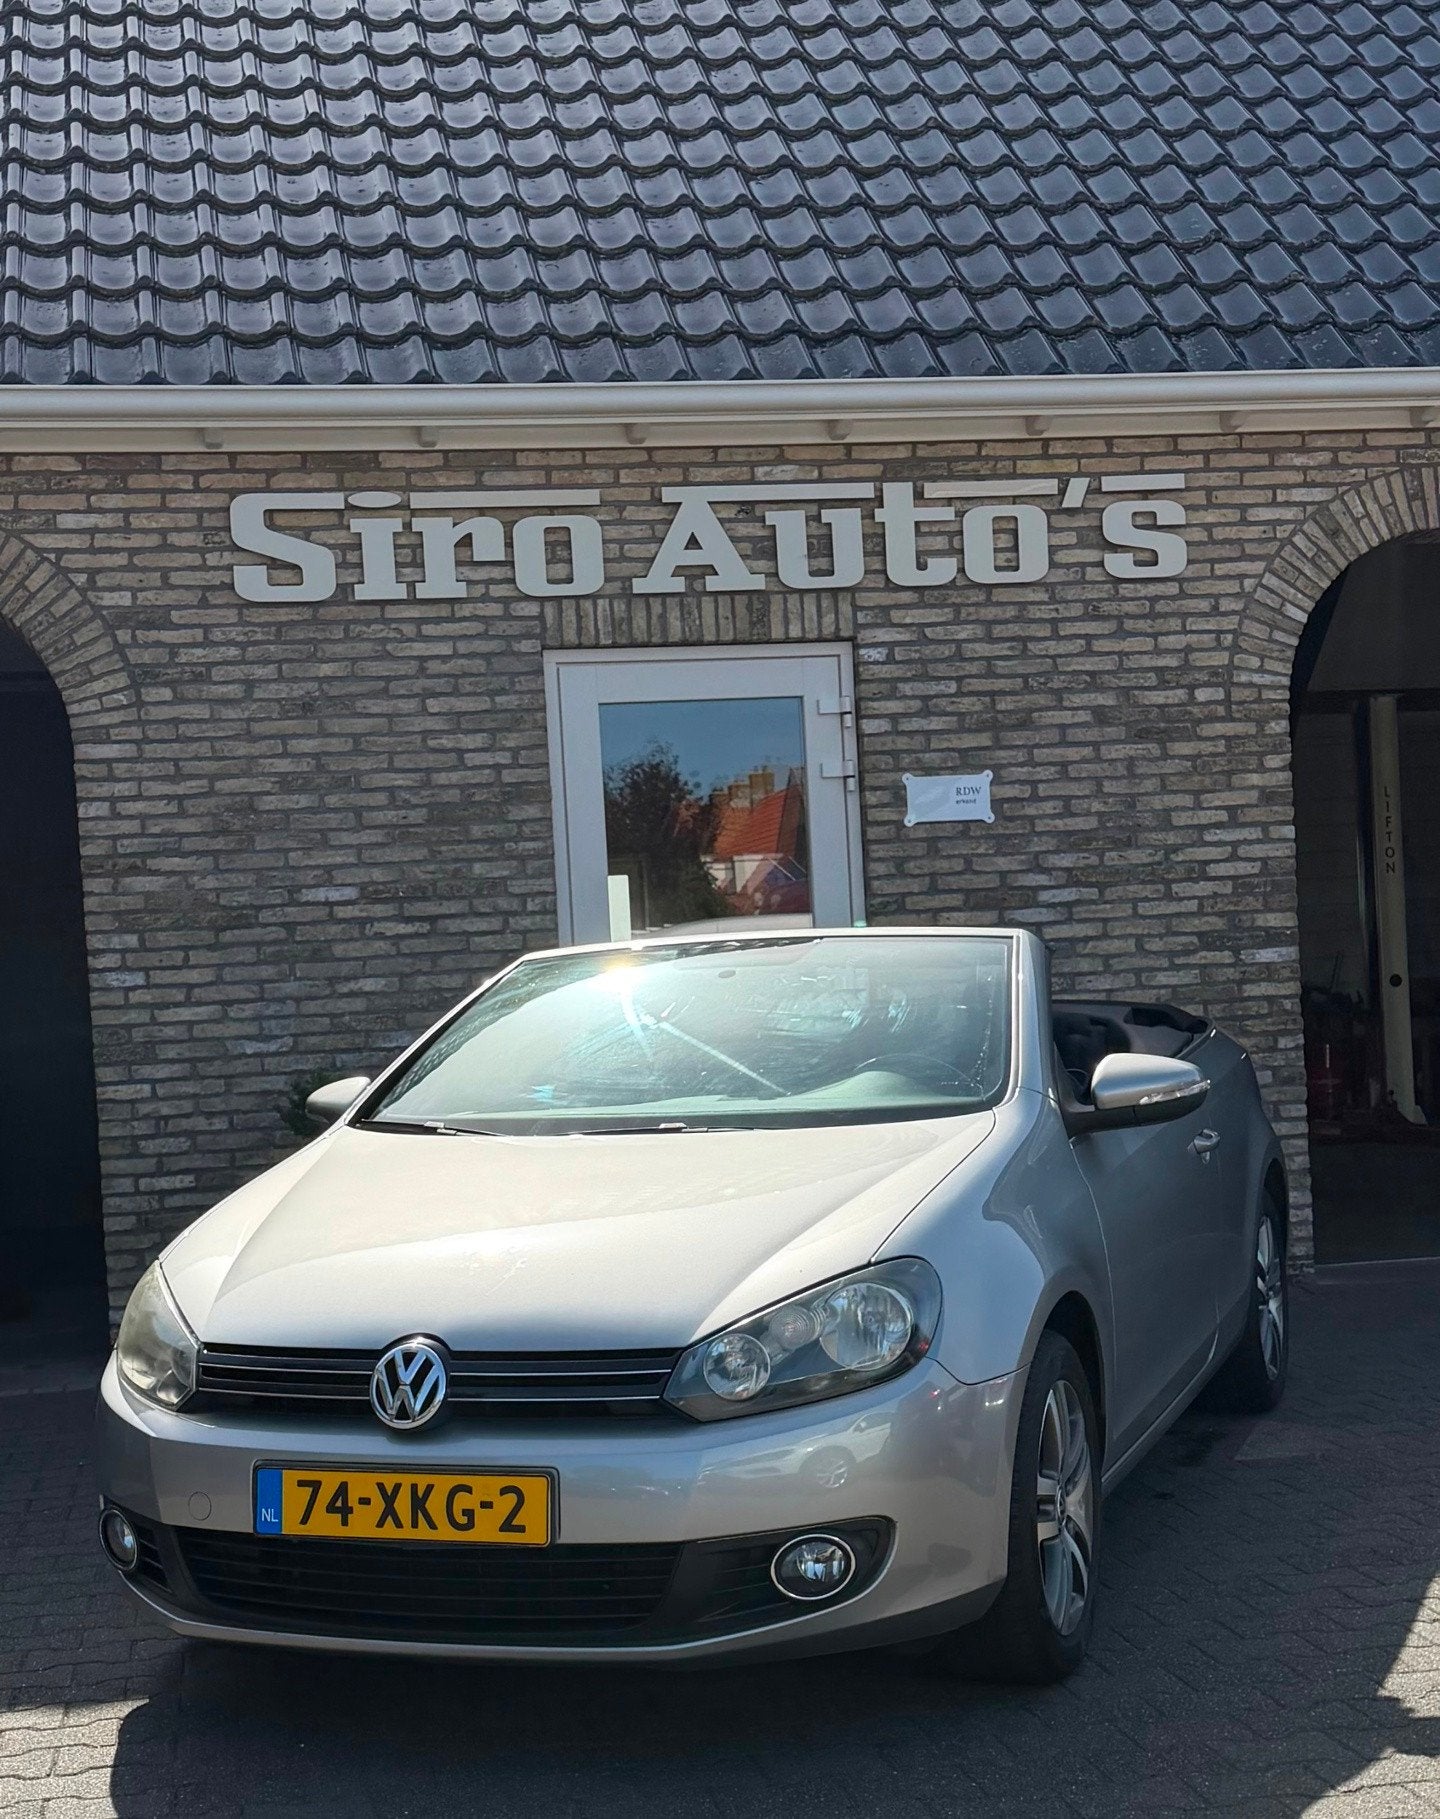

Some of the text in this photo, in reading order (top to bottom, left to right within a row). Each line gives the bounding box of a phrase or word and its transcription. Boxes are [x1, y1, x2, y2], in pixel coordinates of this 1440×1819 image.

[229, 473, 1188, 603] Siro Auto's
[956, 786, 982, 796] RDW
[1384, 786, 1395, 874] LIFTON
[371, 1344, 445, 1428] VW
[261, 1507, 279, 1522] NL
[296, 1479, 527, 1533] 74-XKG-2
